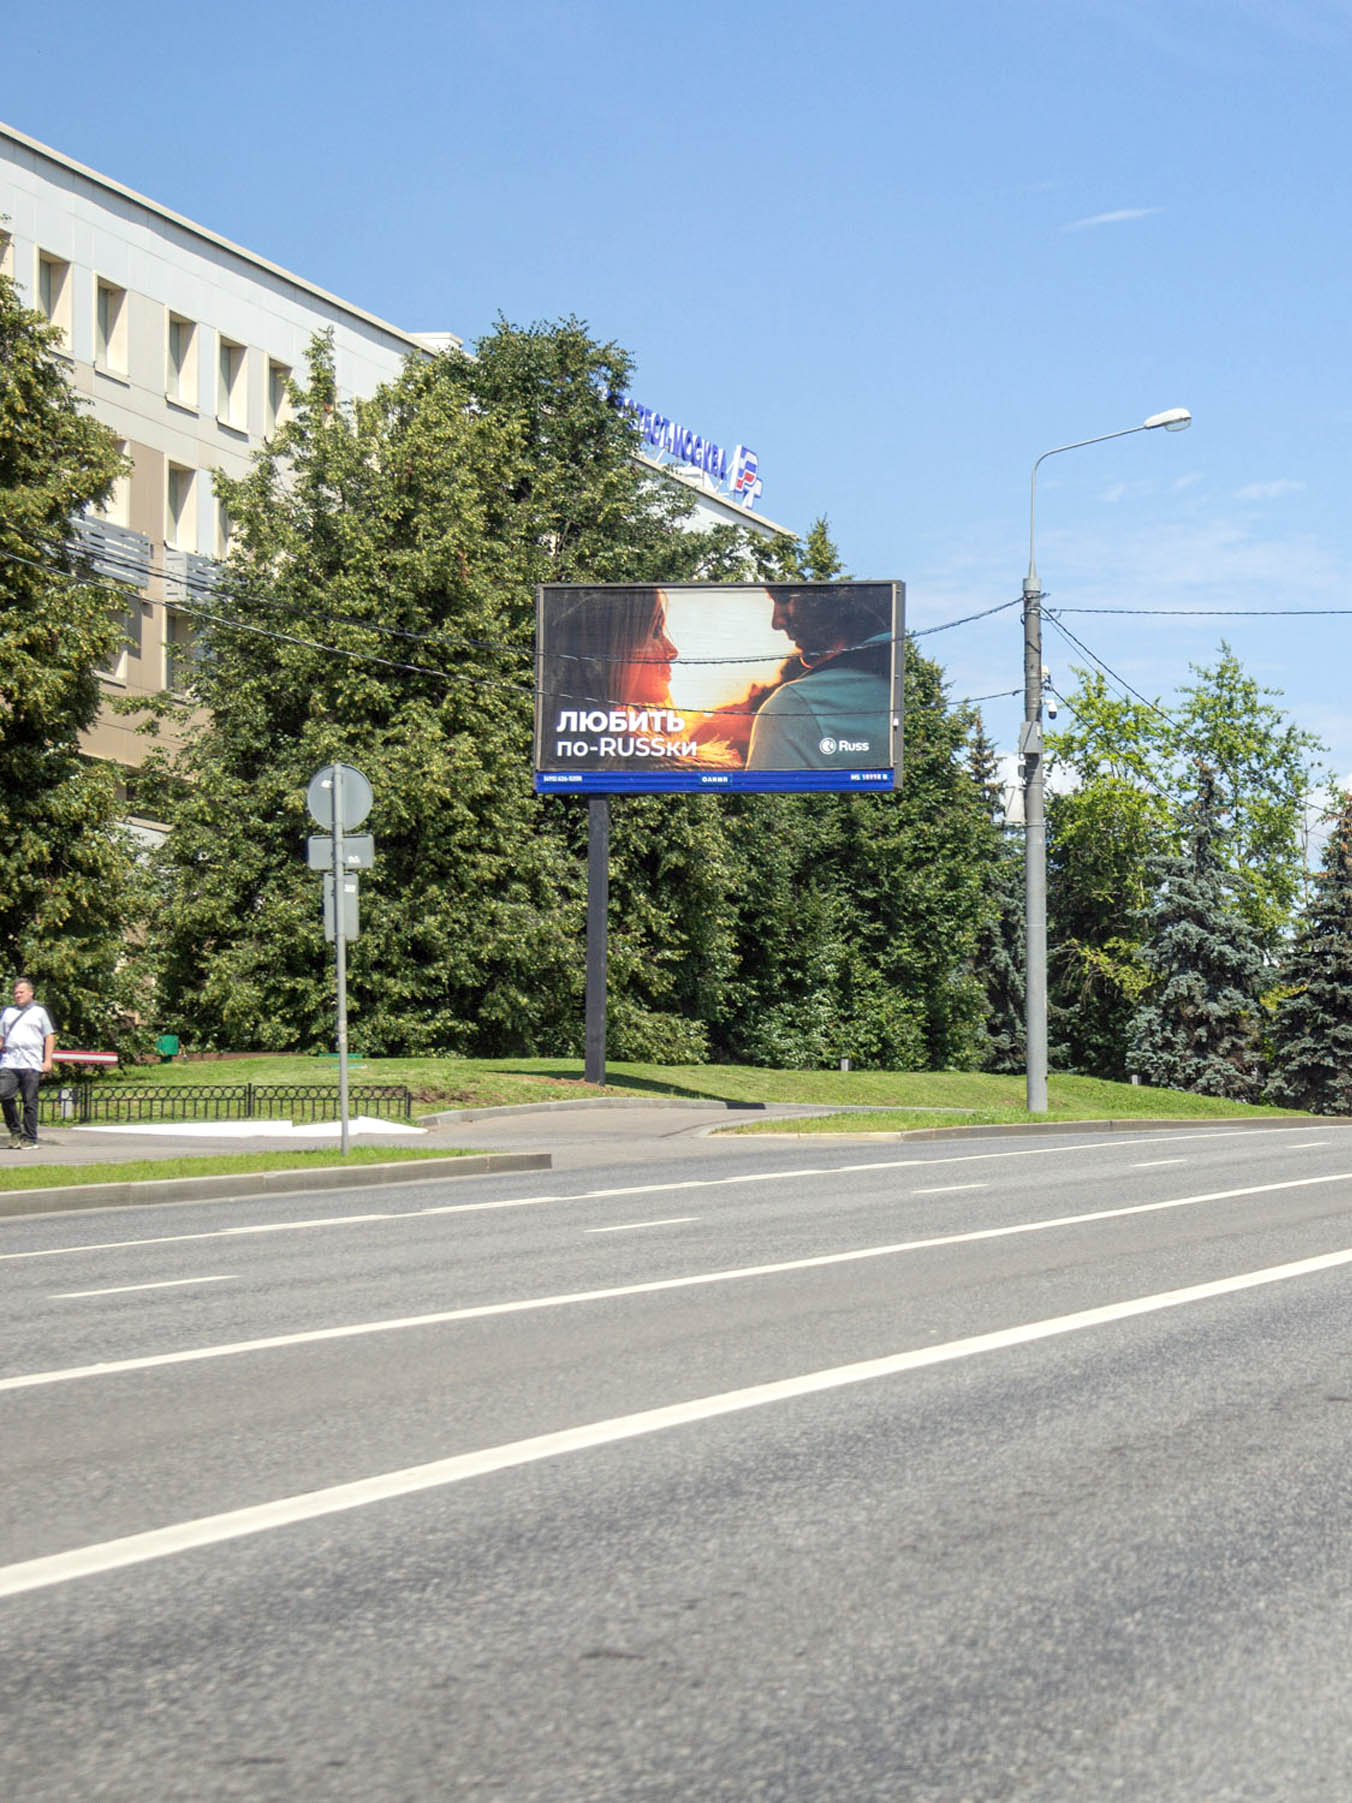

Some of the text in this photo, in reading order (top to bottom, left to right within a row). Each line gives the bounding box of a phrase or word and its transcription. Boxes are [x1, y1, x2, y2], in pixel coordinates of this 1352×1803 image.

[556, 711, 686, 732] ЛЮБИТЬ
[556, 737, 697, 757] по-RUSSки
[838, 740, 870, 752] Russ
